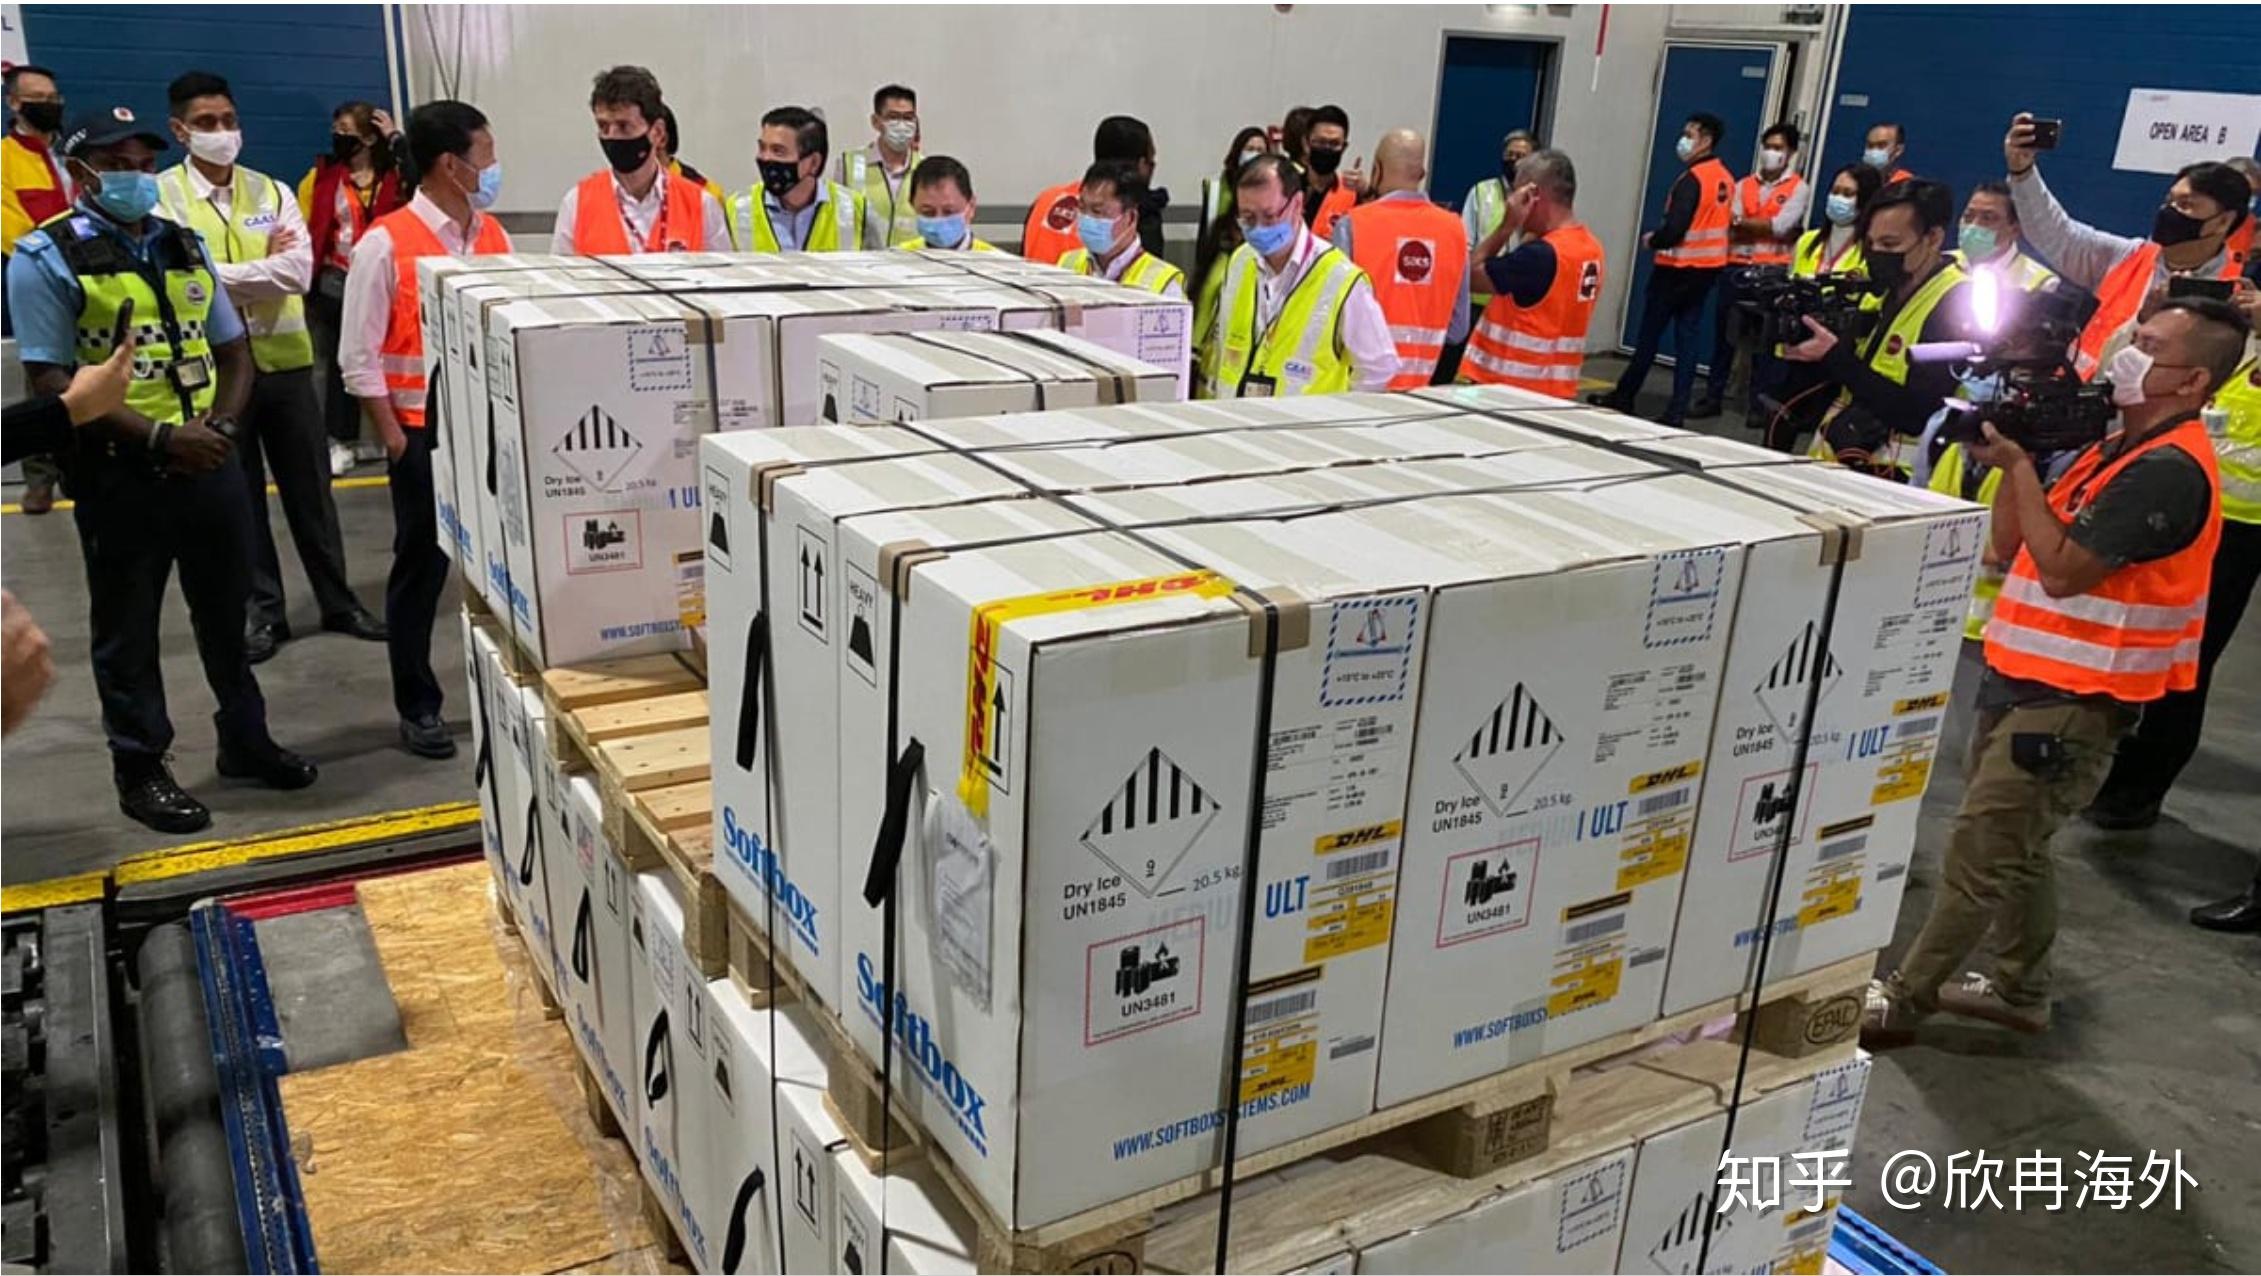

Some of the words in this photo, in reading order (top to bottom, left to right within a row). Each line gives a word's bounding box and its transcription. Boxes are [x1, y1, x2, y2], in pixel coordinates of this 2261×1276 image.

[2150, 122, 2178, 140] OPEN
[2179, 124, 2209, 143] AREA
[2217, 126, 2228, 145] B
[544, 474, 562, 486] Dry
[849, 579, 874, 607] HEAVY
[1736, 726, 1755, 741] Dry
[1859, 725, 1889, 758] ULT
[1434, 800, 1457, 815] Dry
[1460, 796, 1481, 808] Ice
[1432, 812, 1482, 833] UN1845
[1591, 801, 1628, 838] ULT
[1336, 825, 1384, 848] DHL
[723, 806, 819, 942] Softbox
[1064, 883, 1093, 900] Dry
[1097, 874, 1122, 891] Ice
[1193, 870, 1223, 892] 20.5
[1063, 892, 1127, 921] UN1845
[1265, 875, 1311, 918] ULT
[1467, 904, 1511, 925] UN3481
[1121, 991, 1176, 1018] UN3481
[857, 952, 987, 1140] Softbox
